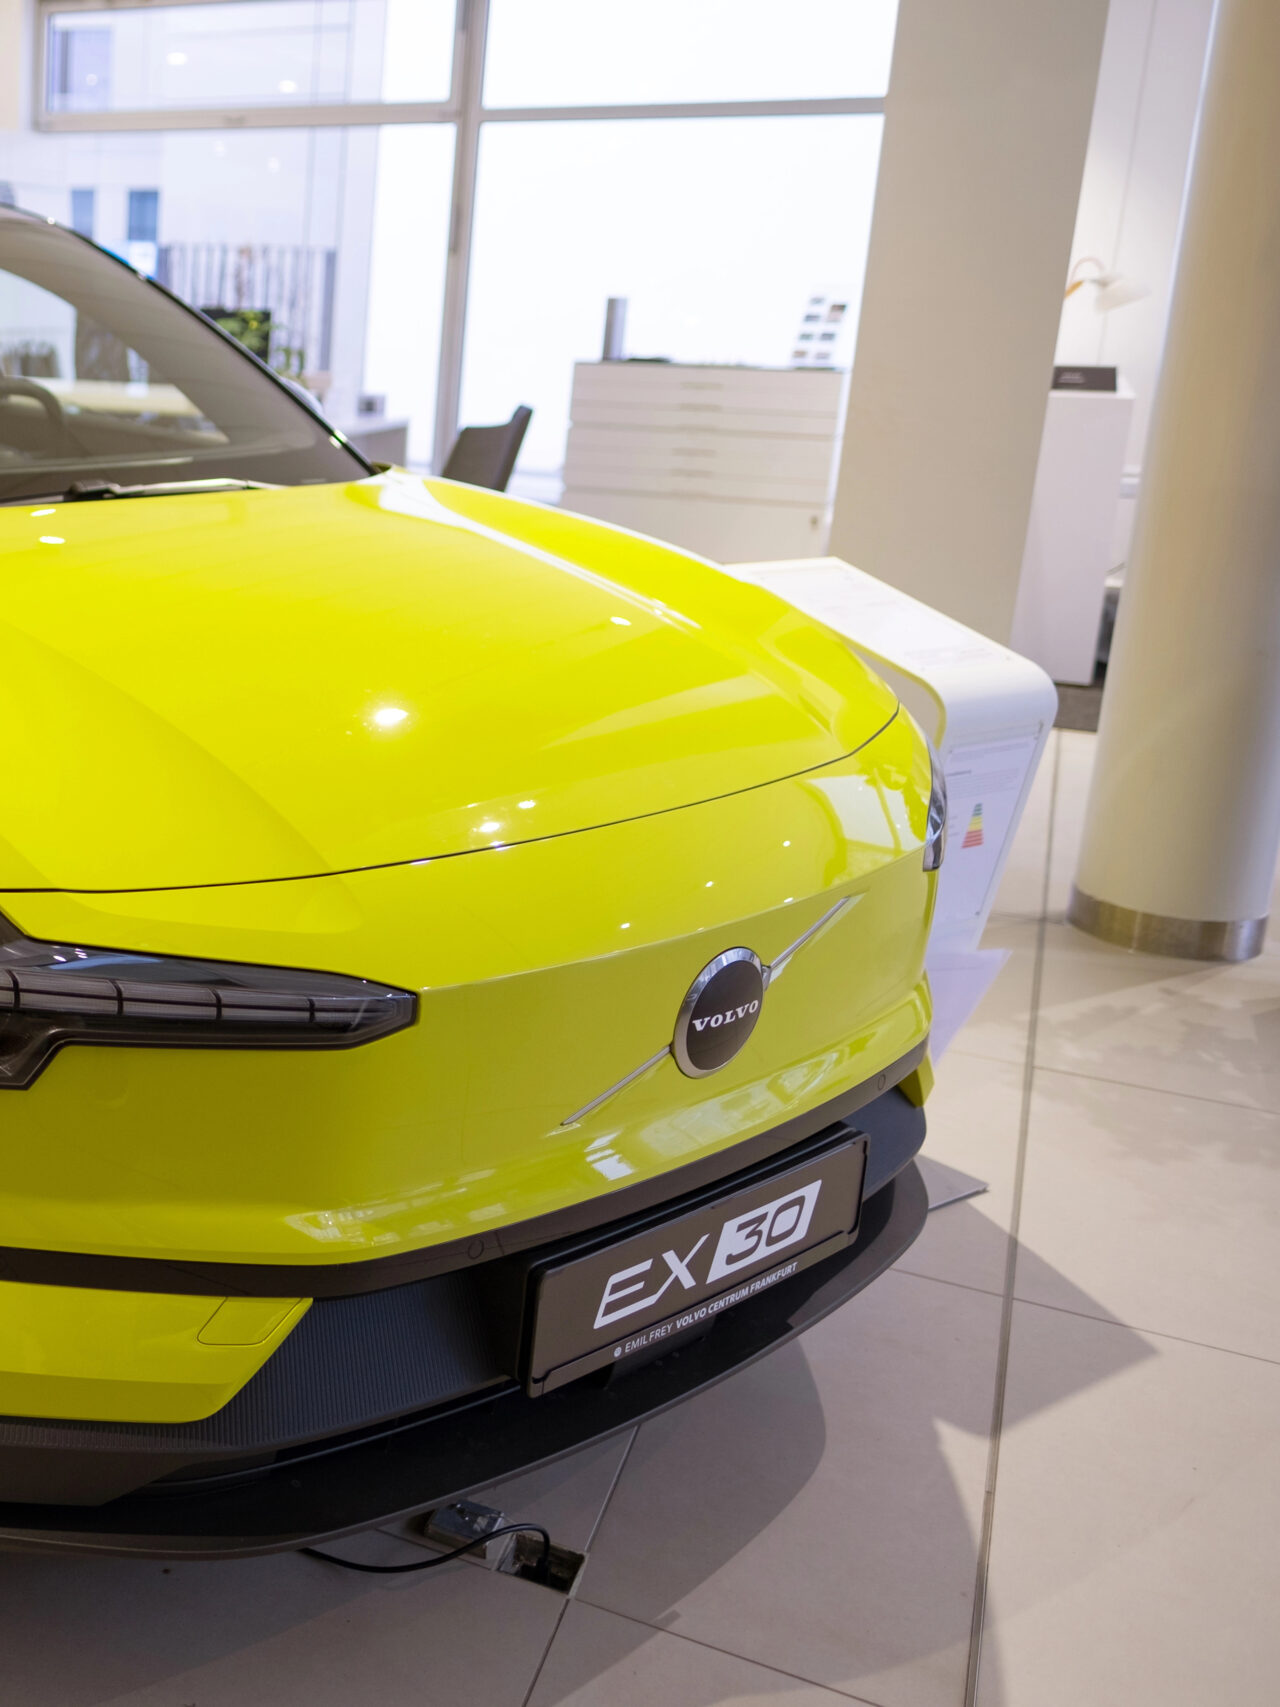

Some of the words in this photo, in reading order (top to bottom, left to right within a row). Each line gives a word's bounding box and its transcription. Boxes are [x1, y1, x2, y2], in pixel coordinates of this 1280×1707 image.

[691, 999, 759, 1032] VOLVO
[624, 1336, 649, 1353] EMIL
[648, 1323, 673, 1343] FREY
[675, 1306, 708, 1329] VOLVO
[707, 1288, 750, 1314] CENTRUM
[749, 1261, 799, 1293] FRANKFURT
